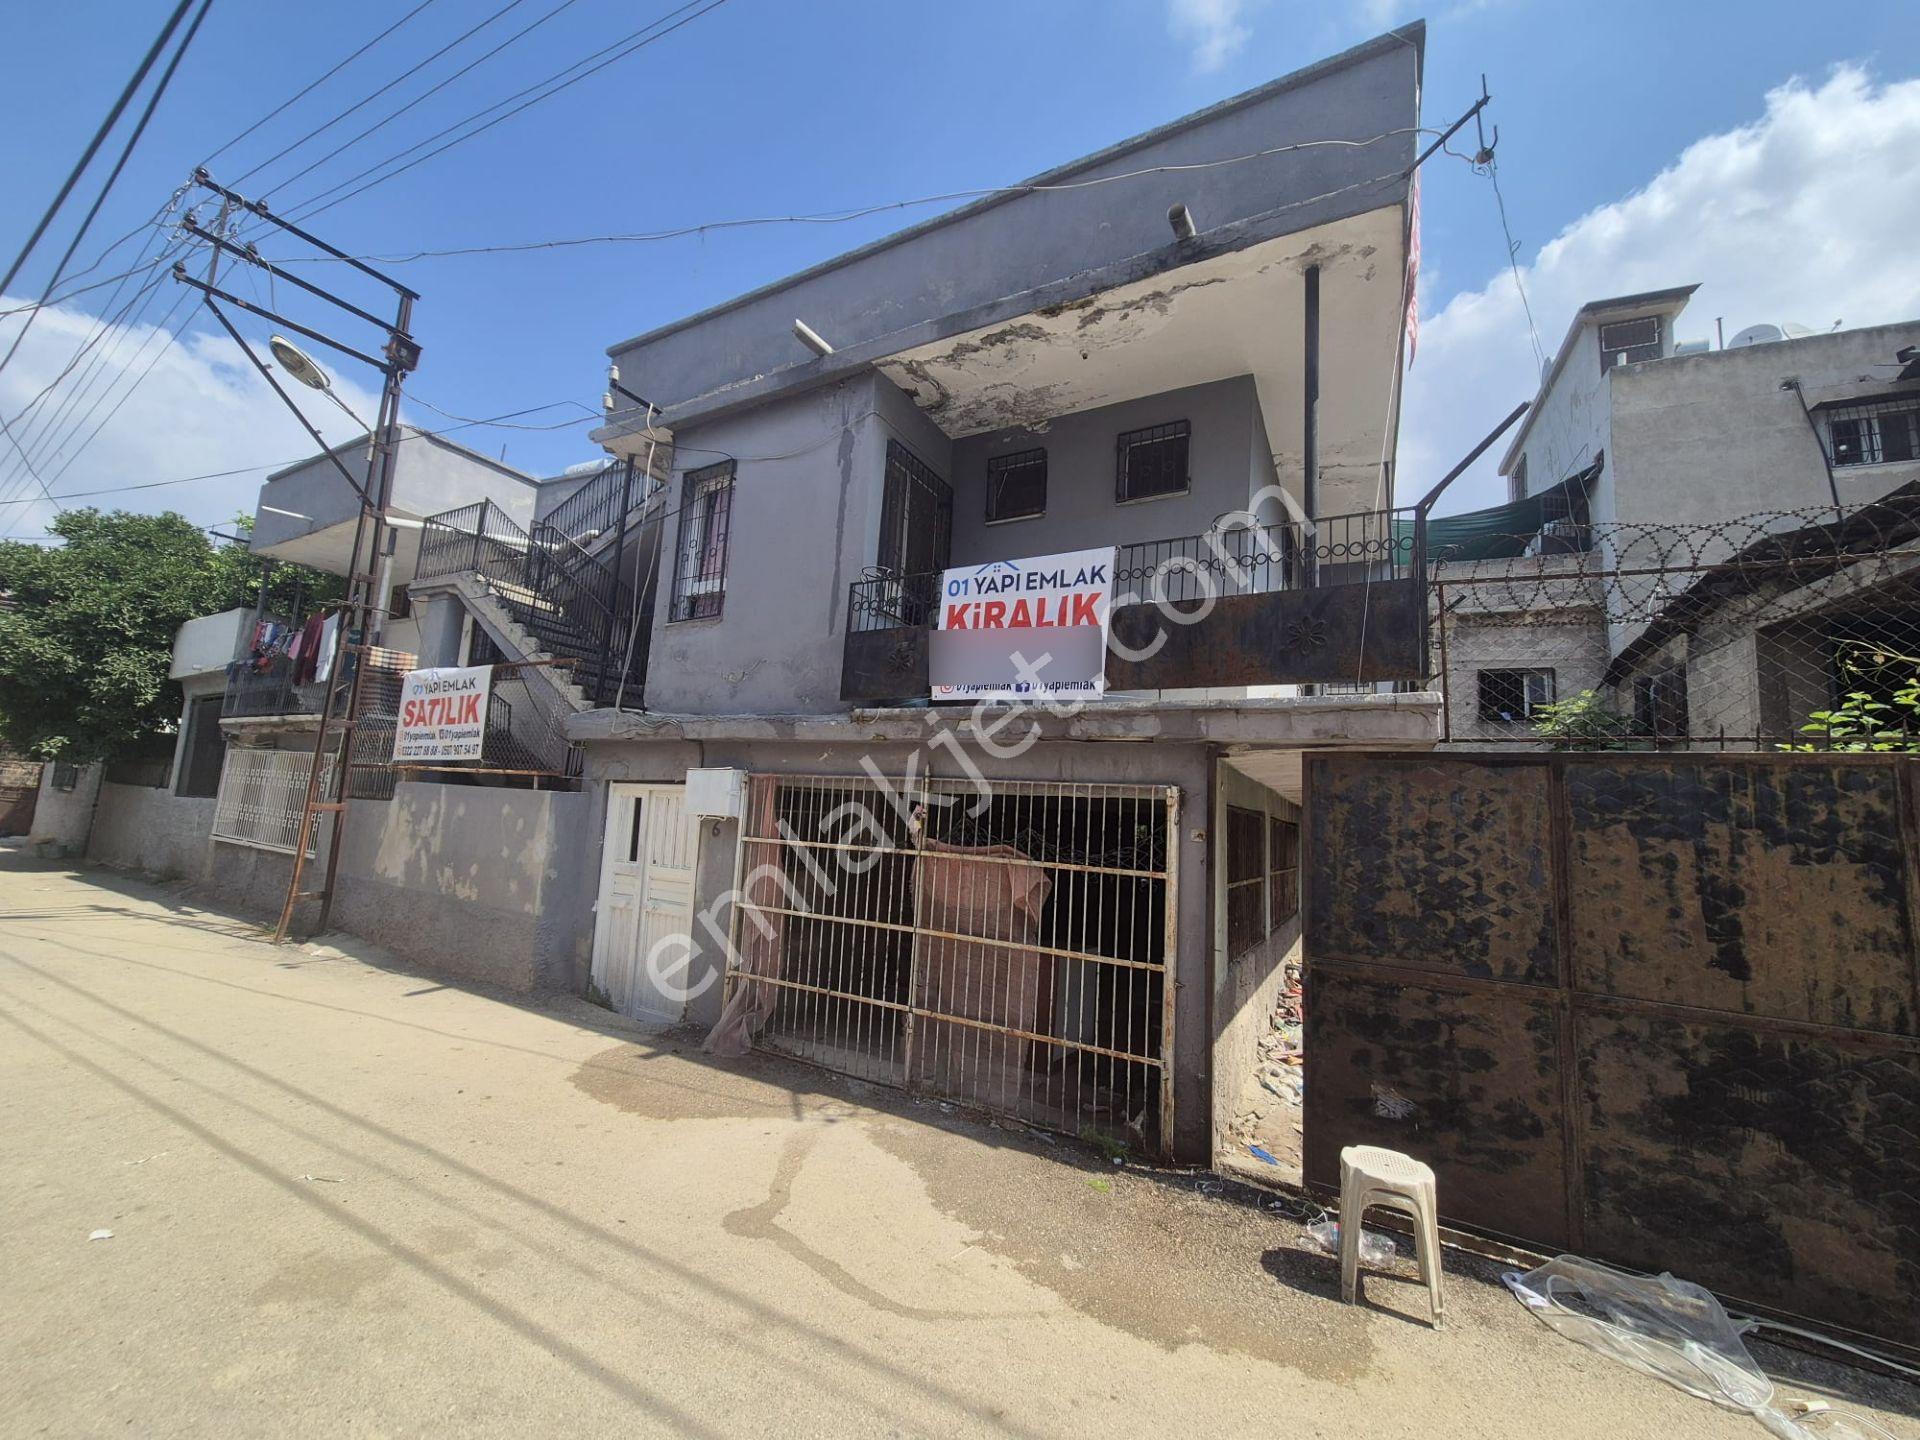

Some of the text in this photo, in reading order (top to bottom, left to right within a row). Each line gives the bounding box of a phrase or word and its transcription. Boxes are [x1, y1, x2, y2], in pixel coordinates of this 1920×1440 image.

[947, 565, 1107, 597] 01 YAPI EMLAK
[424, 681, 442, 694] YAPI
[443, 677, 476, 692] EMLAK
[402, 693, 482, 727] SATILIK
[712, 821, 721, 837] 6
